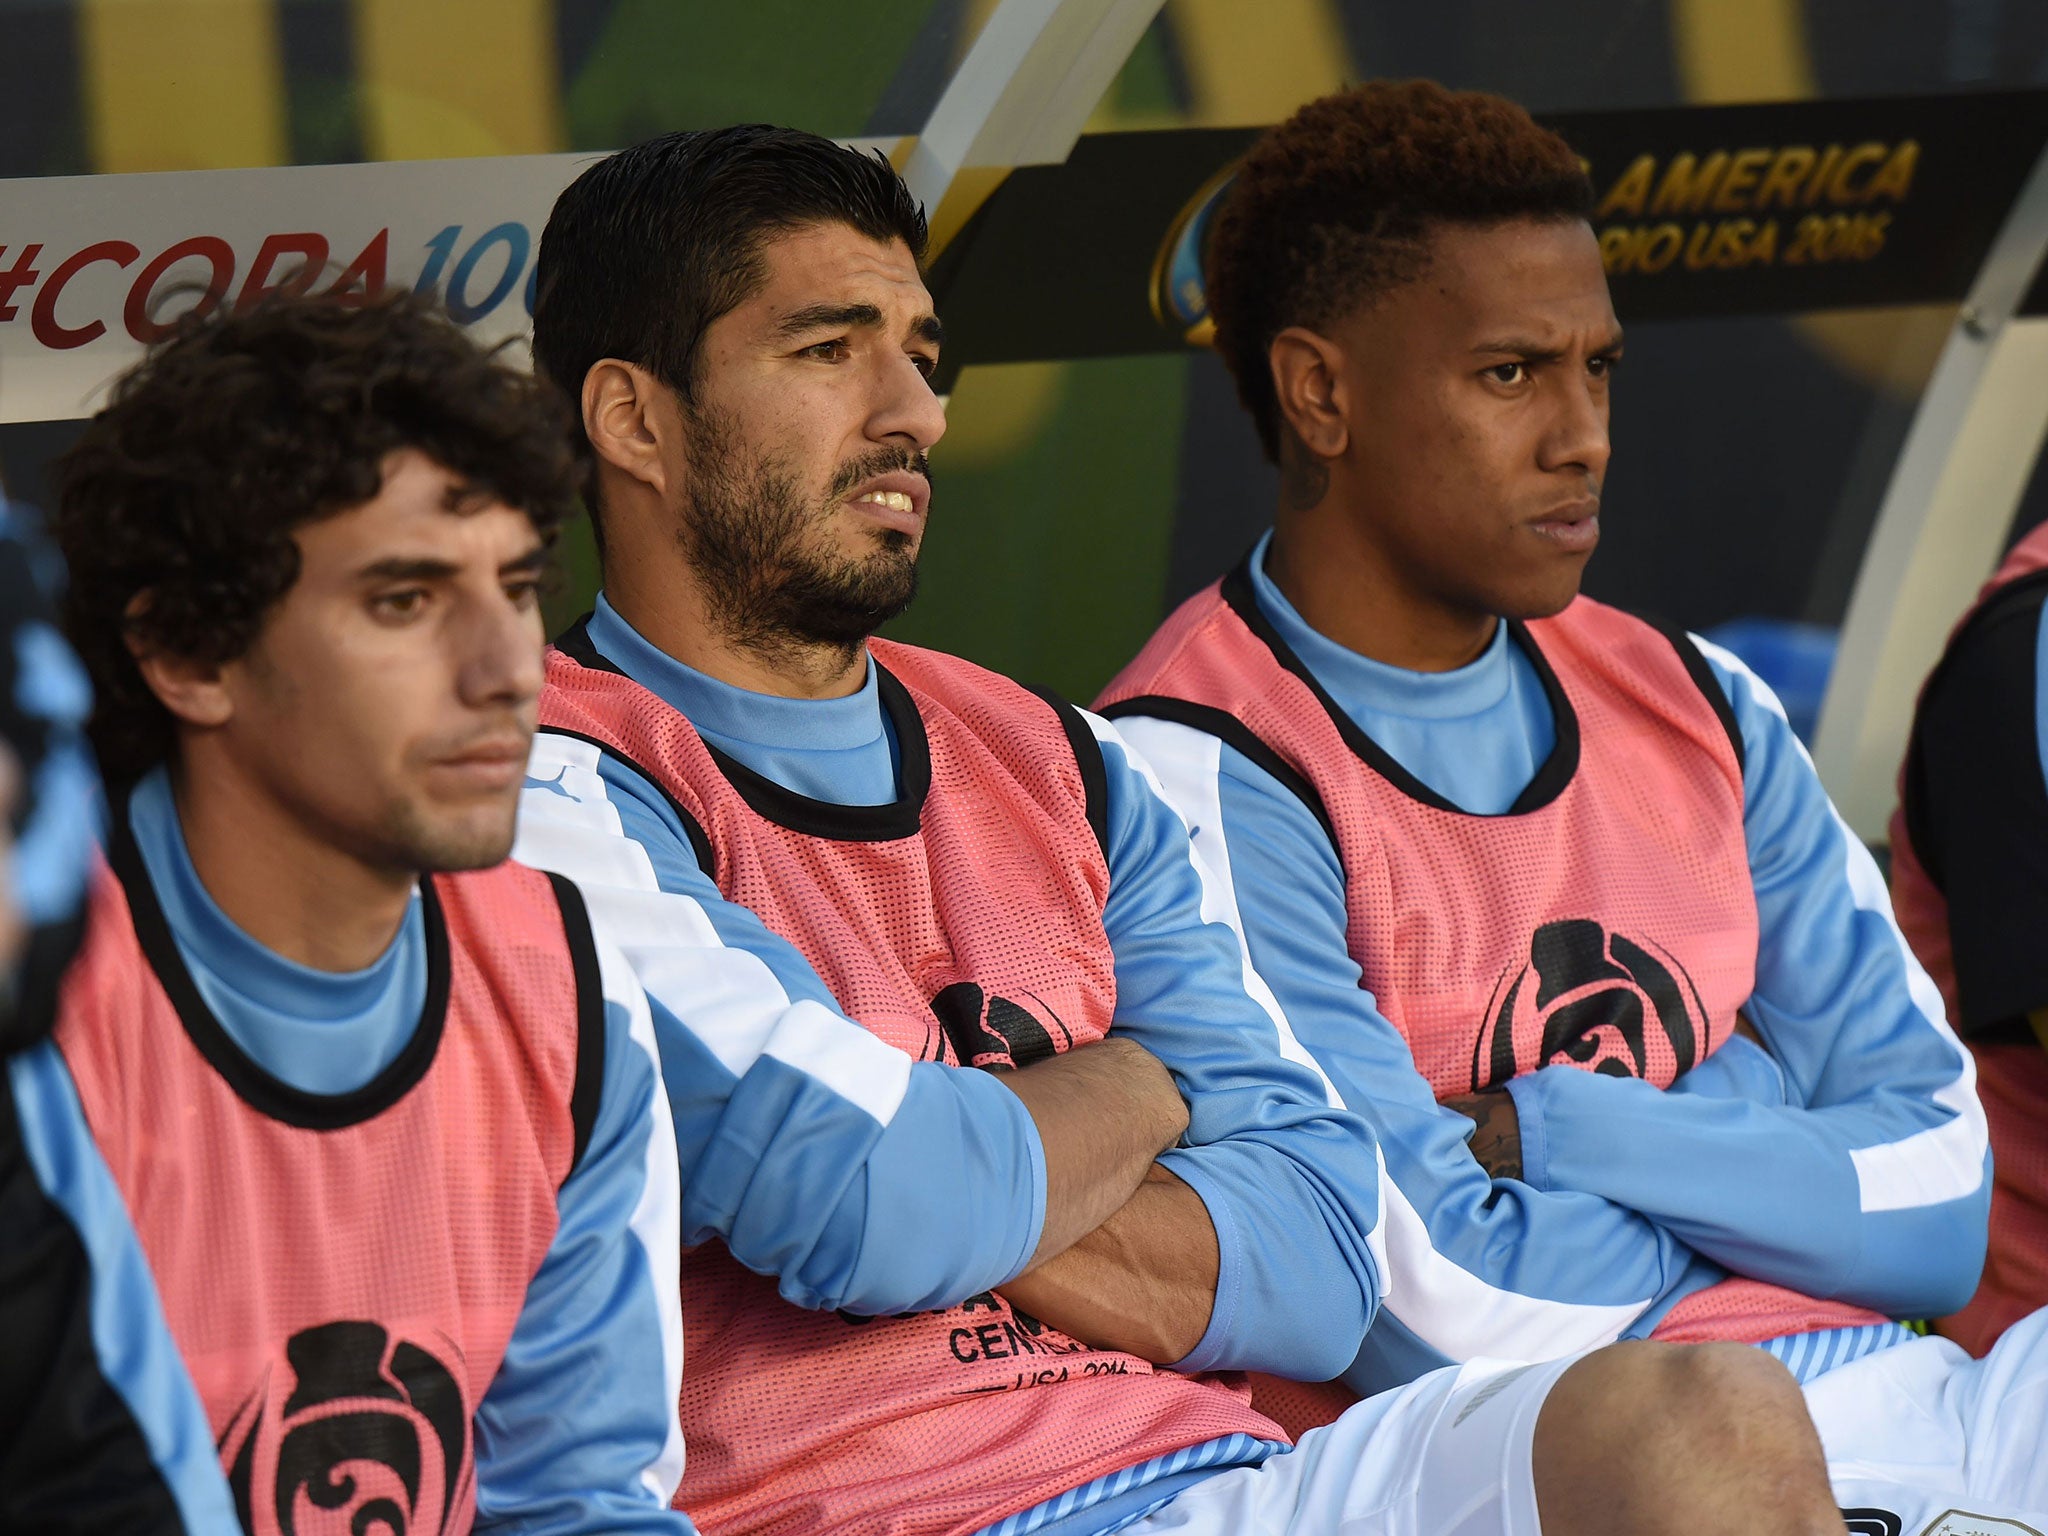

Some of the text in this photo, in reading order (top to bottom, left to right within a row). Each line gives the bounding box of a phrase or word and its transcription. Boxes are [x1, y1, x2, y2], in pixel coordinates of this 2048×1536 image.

[1596, 139, 1921, 219] AMERICA
[1601, 209, 1893, 276] RIO USA 2016
[0, 222, 541, 350] #COPA10
